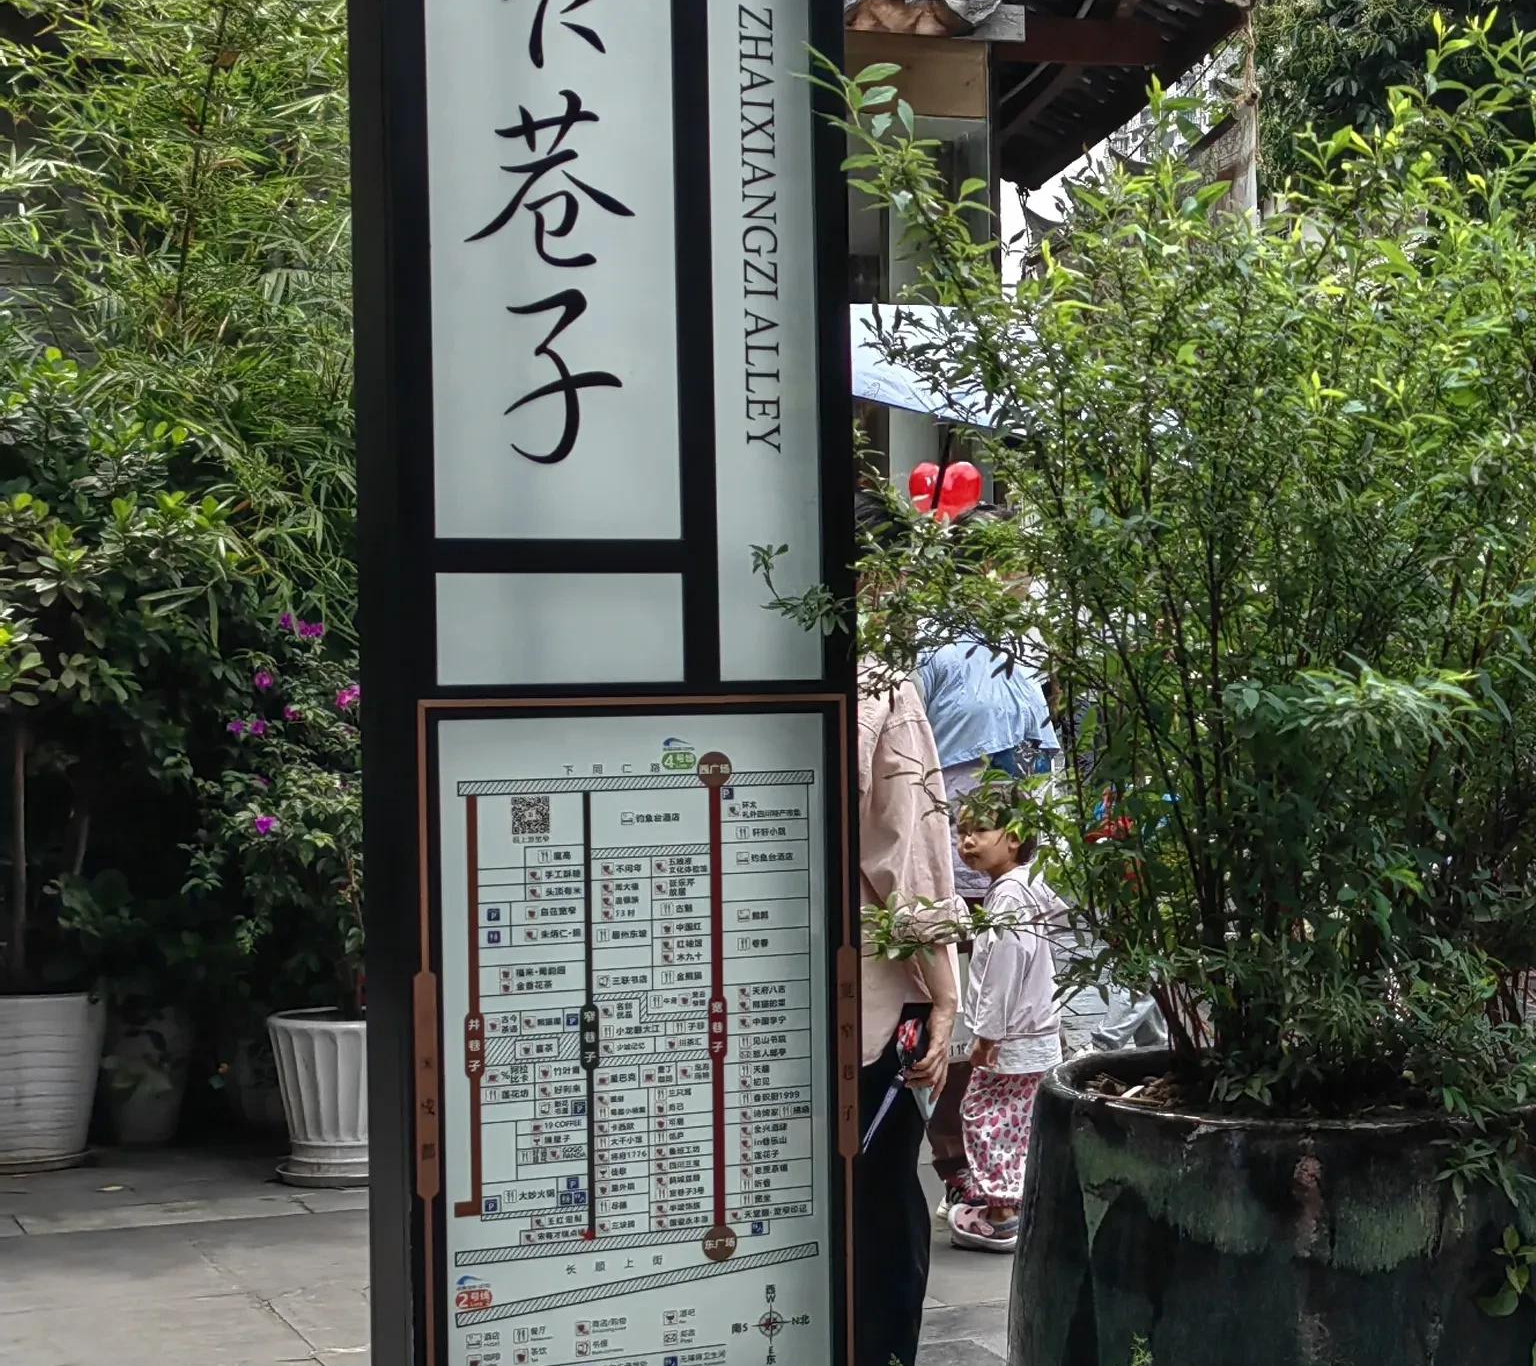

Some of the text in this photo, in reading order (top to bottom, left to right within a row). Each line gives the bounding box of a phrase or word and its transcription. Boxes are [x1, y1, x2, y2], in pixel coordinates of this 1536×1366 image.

[737, 4, 783, 455] ZHAIXIANGZI ALLEY
[563, 762, 661, 775] 下同仁路
[698, 763, 730, 775] 西广场
[635, 812, 681, 823] 钓鱼台酒店
[751, 852, 795, 863] 钓鱼台酒店
[710, 1001, 724, 1054] 宽巷子
[752, 1016, 787, 1026] 中国李宁
[554, 1119, 582, 1129] COFFEE
[518, 1188, 556, 1201] 大妙火锅
[703, 1237, 736, 1251] 东广场
[565, 1253, 664, 1276] 长顺上街
